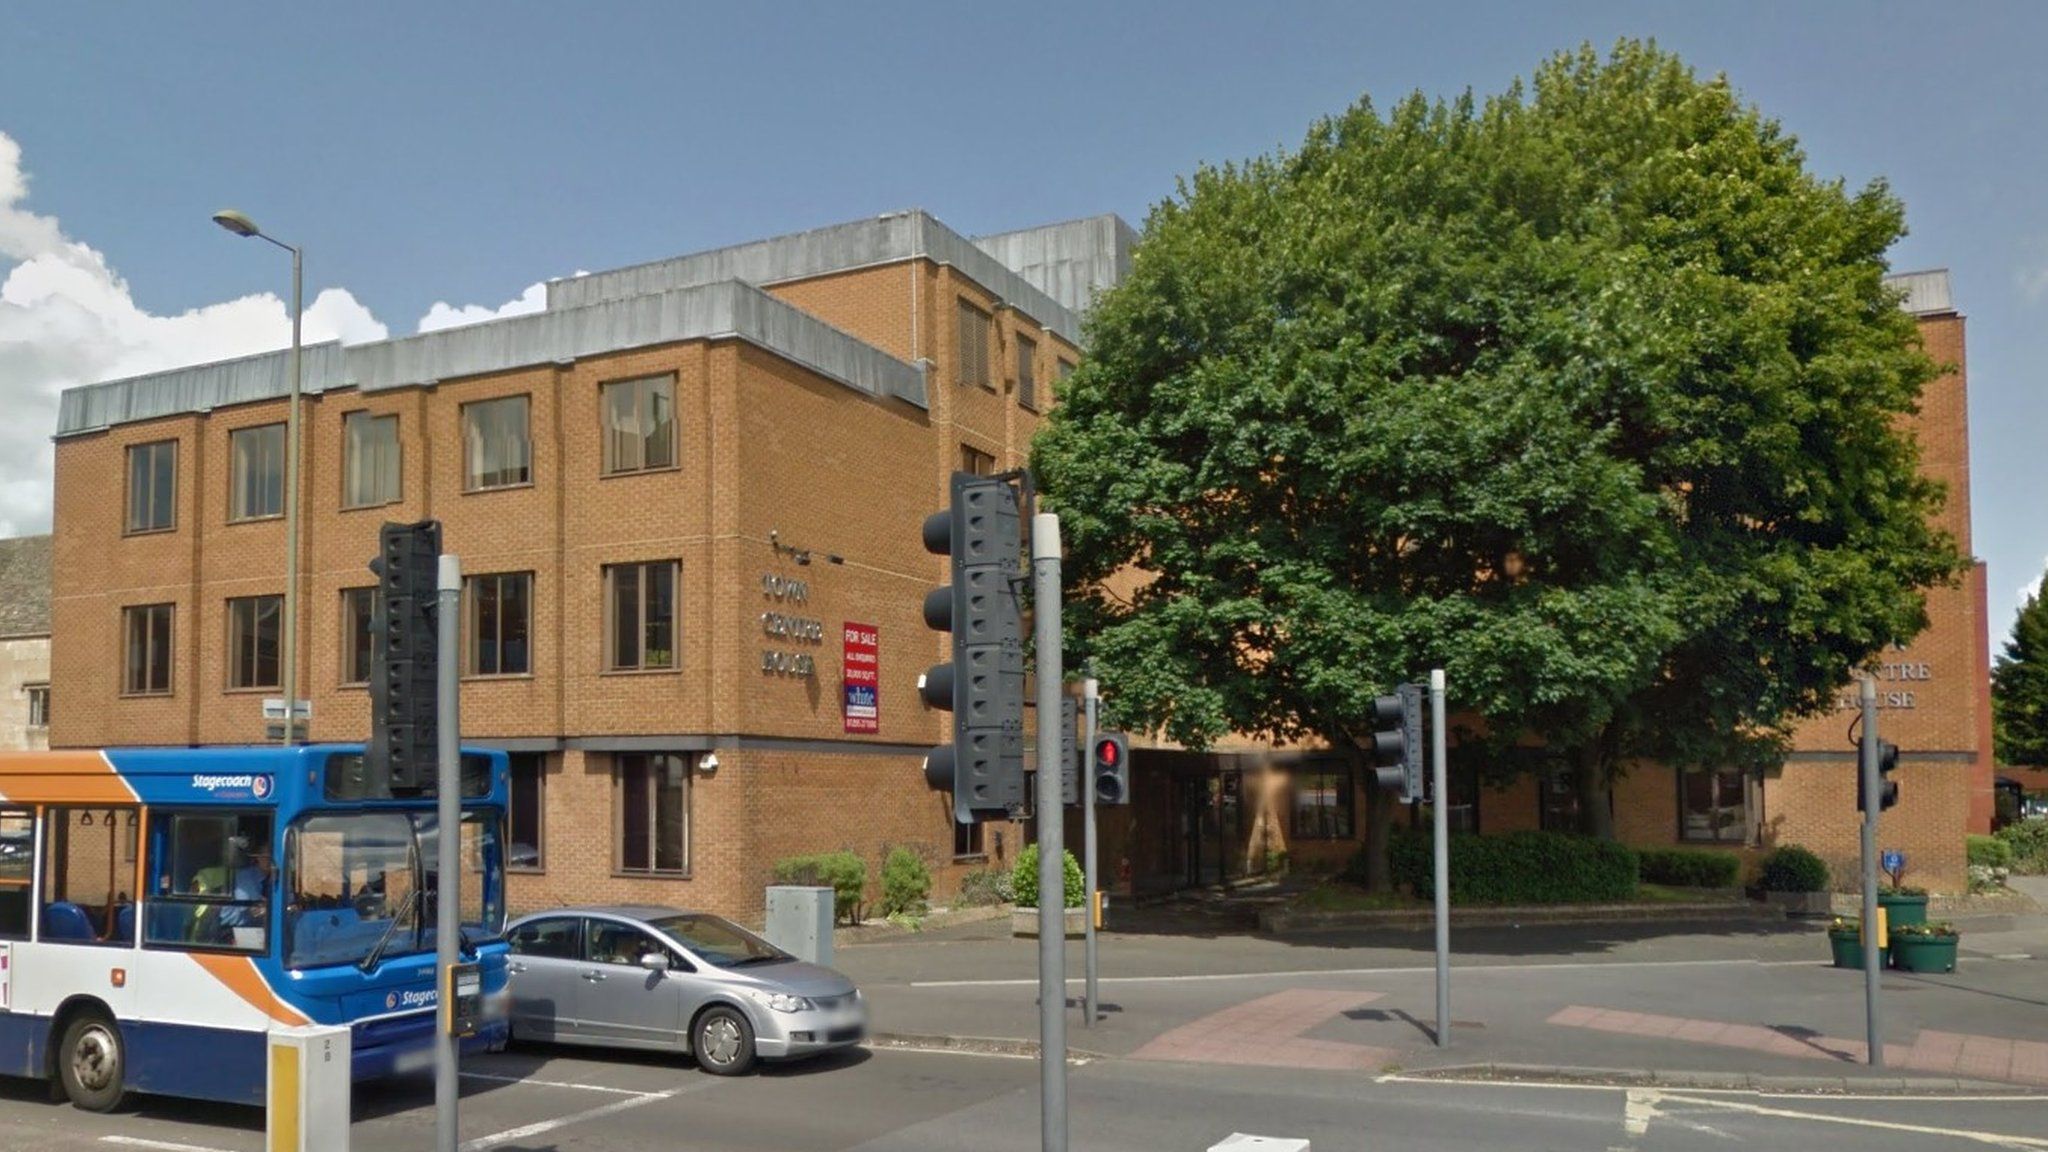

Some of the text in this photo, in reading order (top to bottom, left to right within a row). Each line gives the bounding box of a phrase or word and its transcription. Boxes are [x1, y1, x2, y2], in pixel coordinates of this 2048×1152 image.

[846, 629, 877, 646] FOR SALE
[192, 774, 252, 791] Stagecoach
[402, 990, 438, 1006] Stagec
